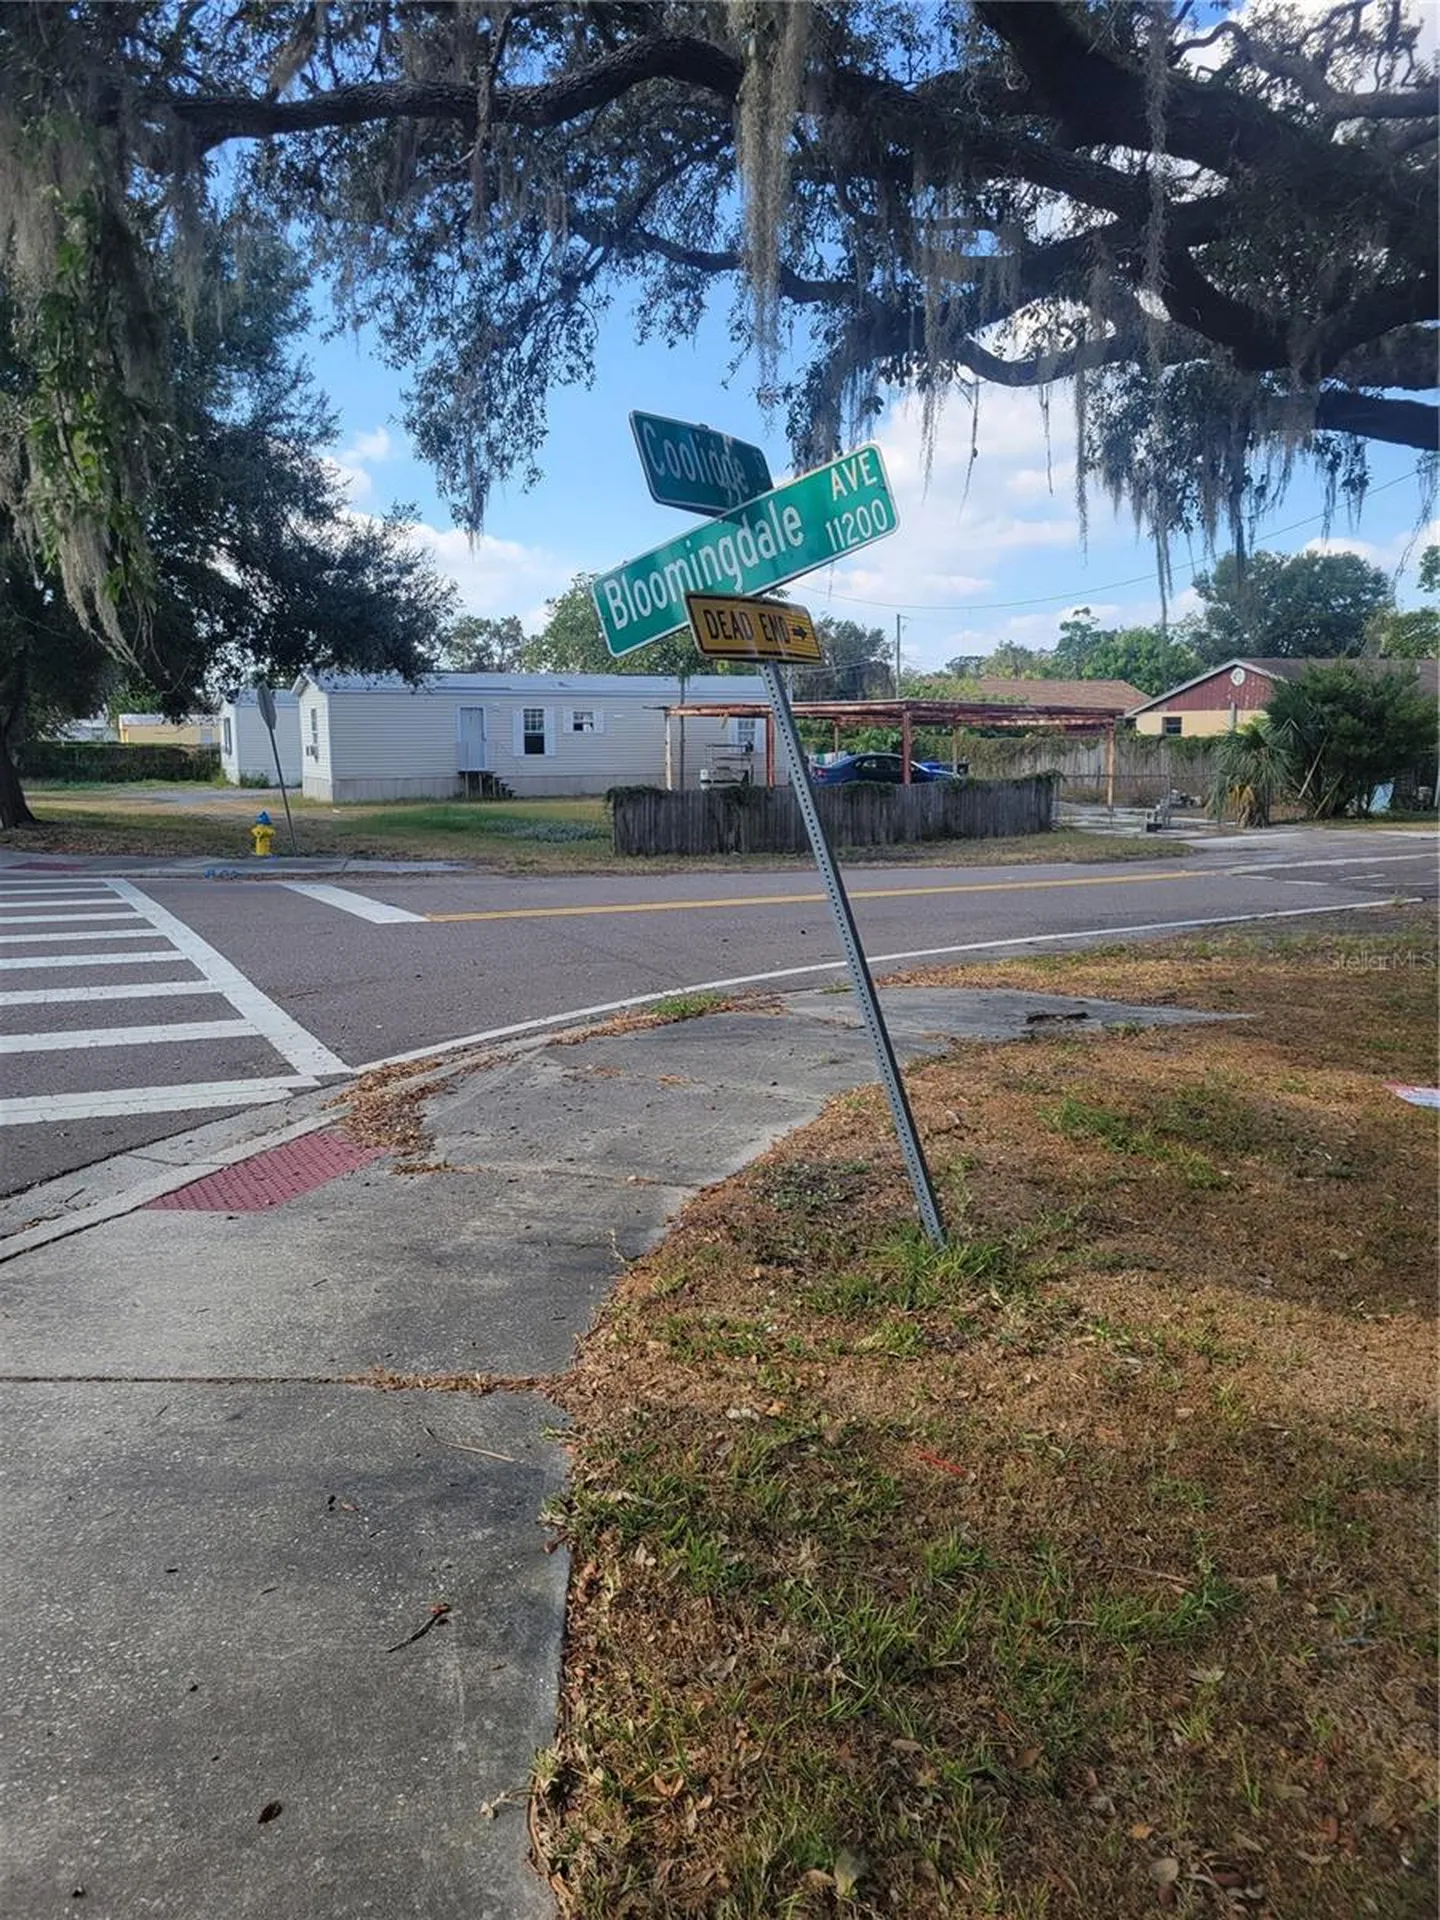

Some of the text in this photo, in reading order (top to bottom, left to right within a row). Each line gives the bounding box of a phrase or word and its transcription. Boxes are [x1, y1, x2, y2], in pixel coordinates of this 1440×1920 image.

[642, 420, 750, 509] Coolidge
[830, 451, 878, 501] AVE
[825, 499, 889, 552] 11200
[603, 500, 804, 631] Bloomingdale
[703, 609, 792, 644] DEAD END
